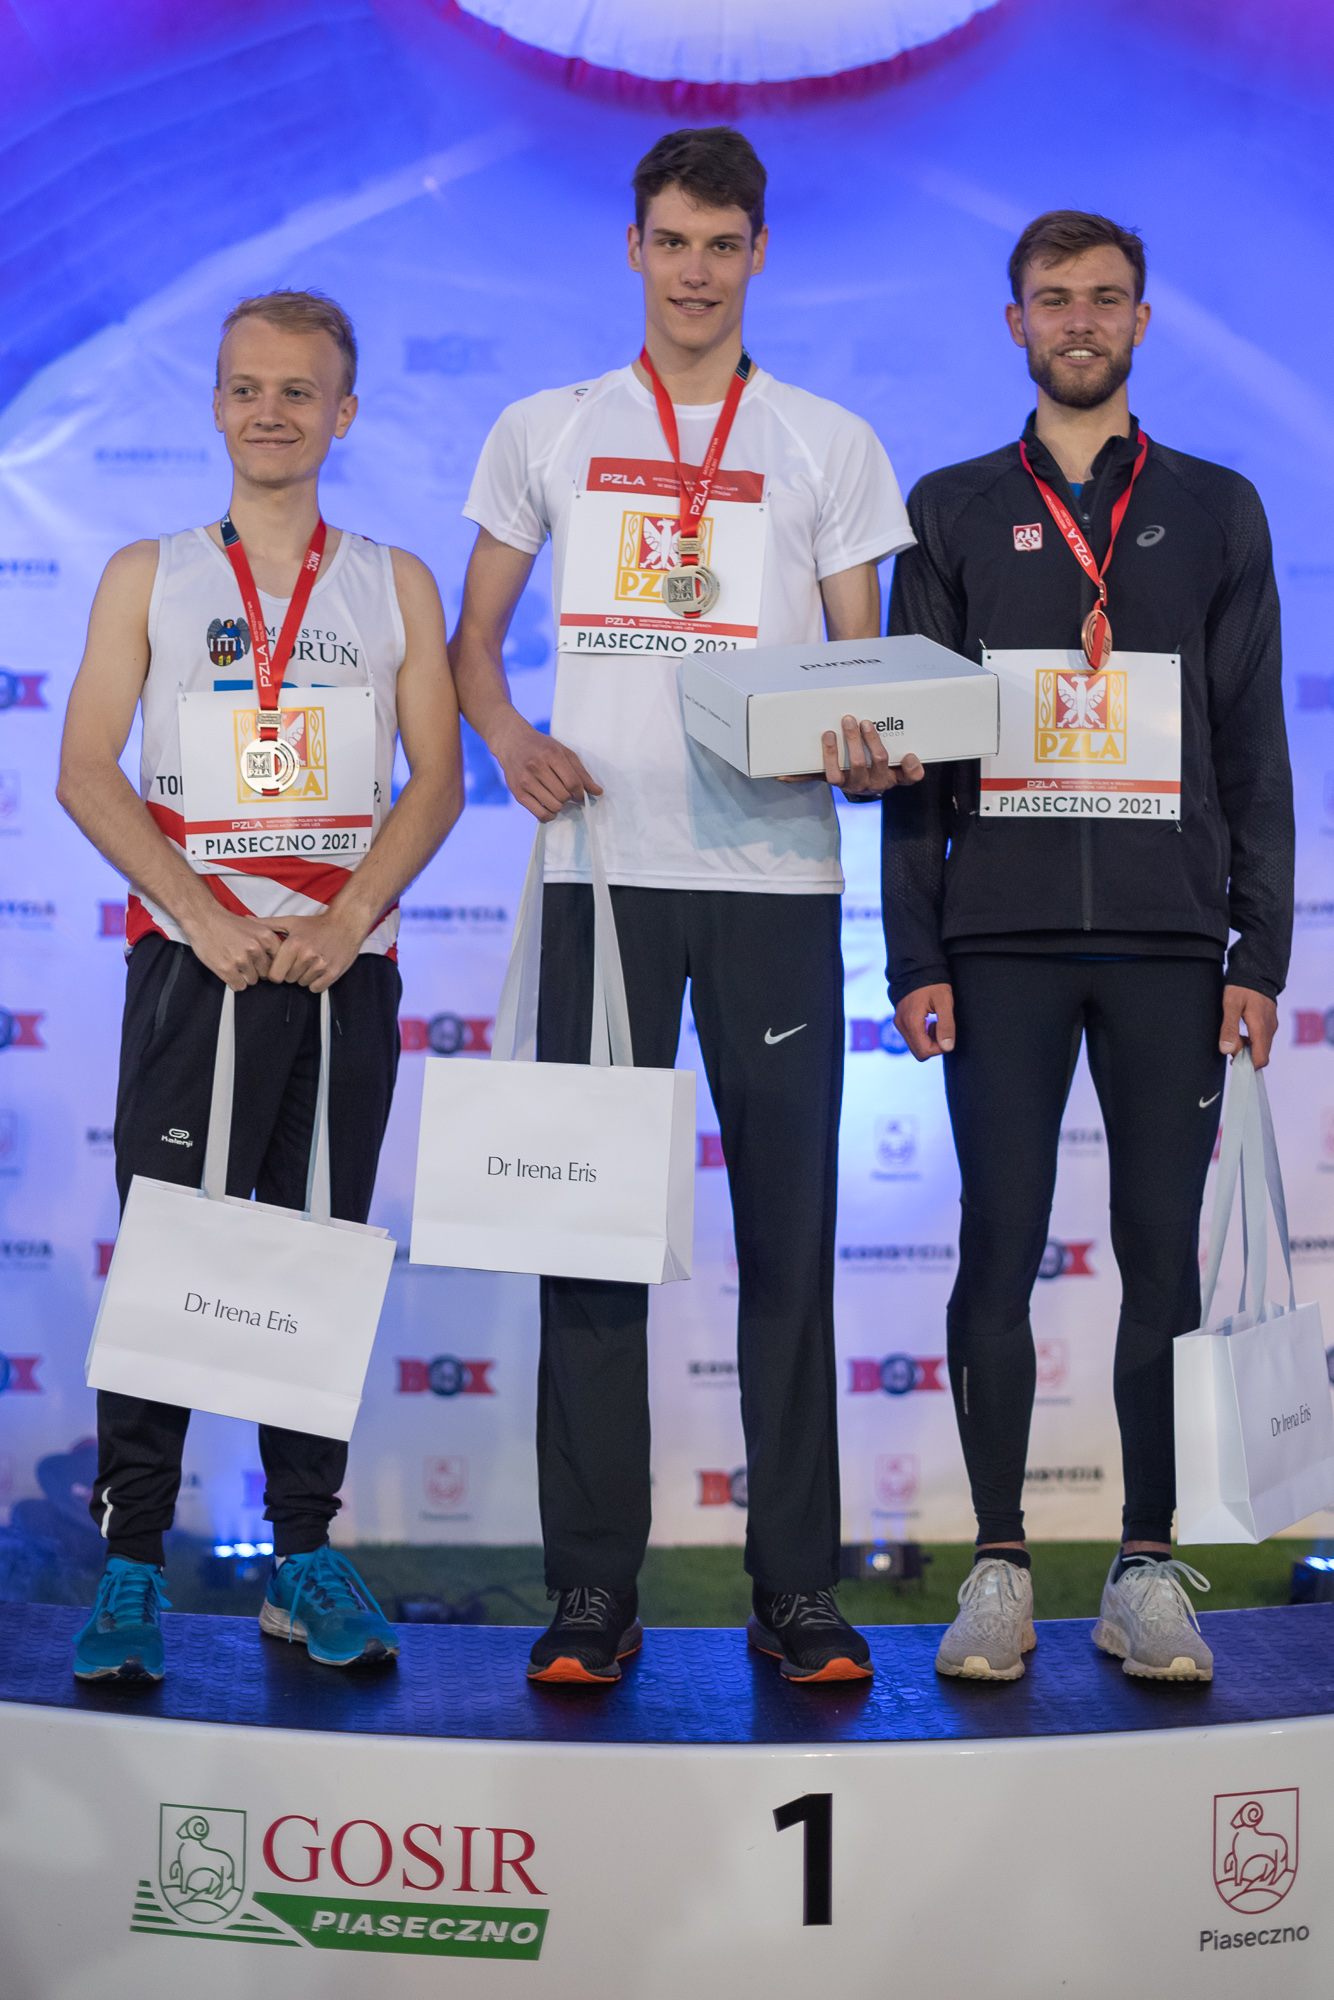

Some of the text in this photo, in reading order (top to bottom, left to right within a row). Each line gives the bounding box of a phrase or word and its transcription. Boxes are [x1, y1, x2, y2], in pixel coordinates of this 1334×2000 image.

[600, 473, 646, 486] PZLA
[690, 479, 712, 516] PZLA
[1066, 527, 1092, 567] PZLA
[306, 550, 321, 572] MCC
[620, 571, 661, 598] PZ
[265, 626, 337, 642] MSTO
[605, 616, 637, 627] PZLA
[268, 640, 359, 668] RUŃ
[577, 631, 738, 653] PIASECZNO 2021
[256, 644, 272, 688] PZLA
[799, 658, 882, 671] purella
[872, 717, 904, 732] ella
[1039, 732, 1121, 759] PZLA
[1026, 780, 1059, 789] PZLA
[1000, 796, 1161, 814] PIASECZNO 2021
[231, 820, 264, 829] PZLA
[205, 833, 357, 855] PIASECZNO 2021
[487, 1156, 597, 1183] Dr Irena Eris
[184, 1292, 299, 1335] Dr Irena Eris
[1270, 1403, 1312, 1437] Dr Irena Eris
[262, 1814, 549, 1896] GOSIR
[772, 1792, 834, 1926] 1
[311, 1910, 539, 1945] PIASECZNO
[1199, 1922, 1310, 1952] Piaseczno
